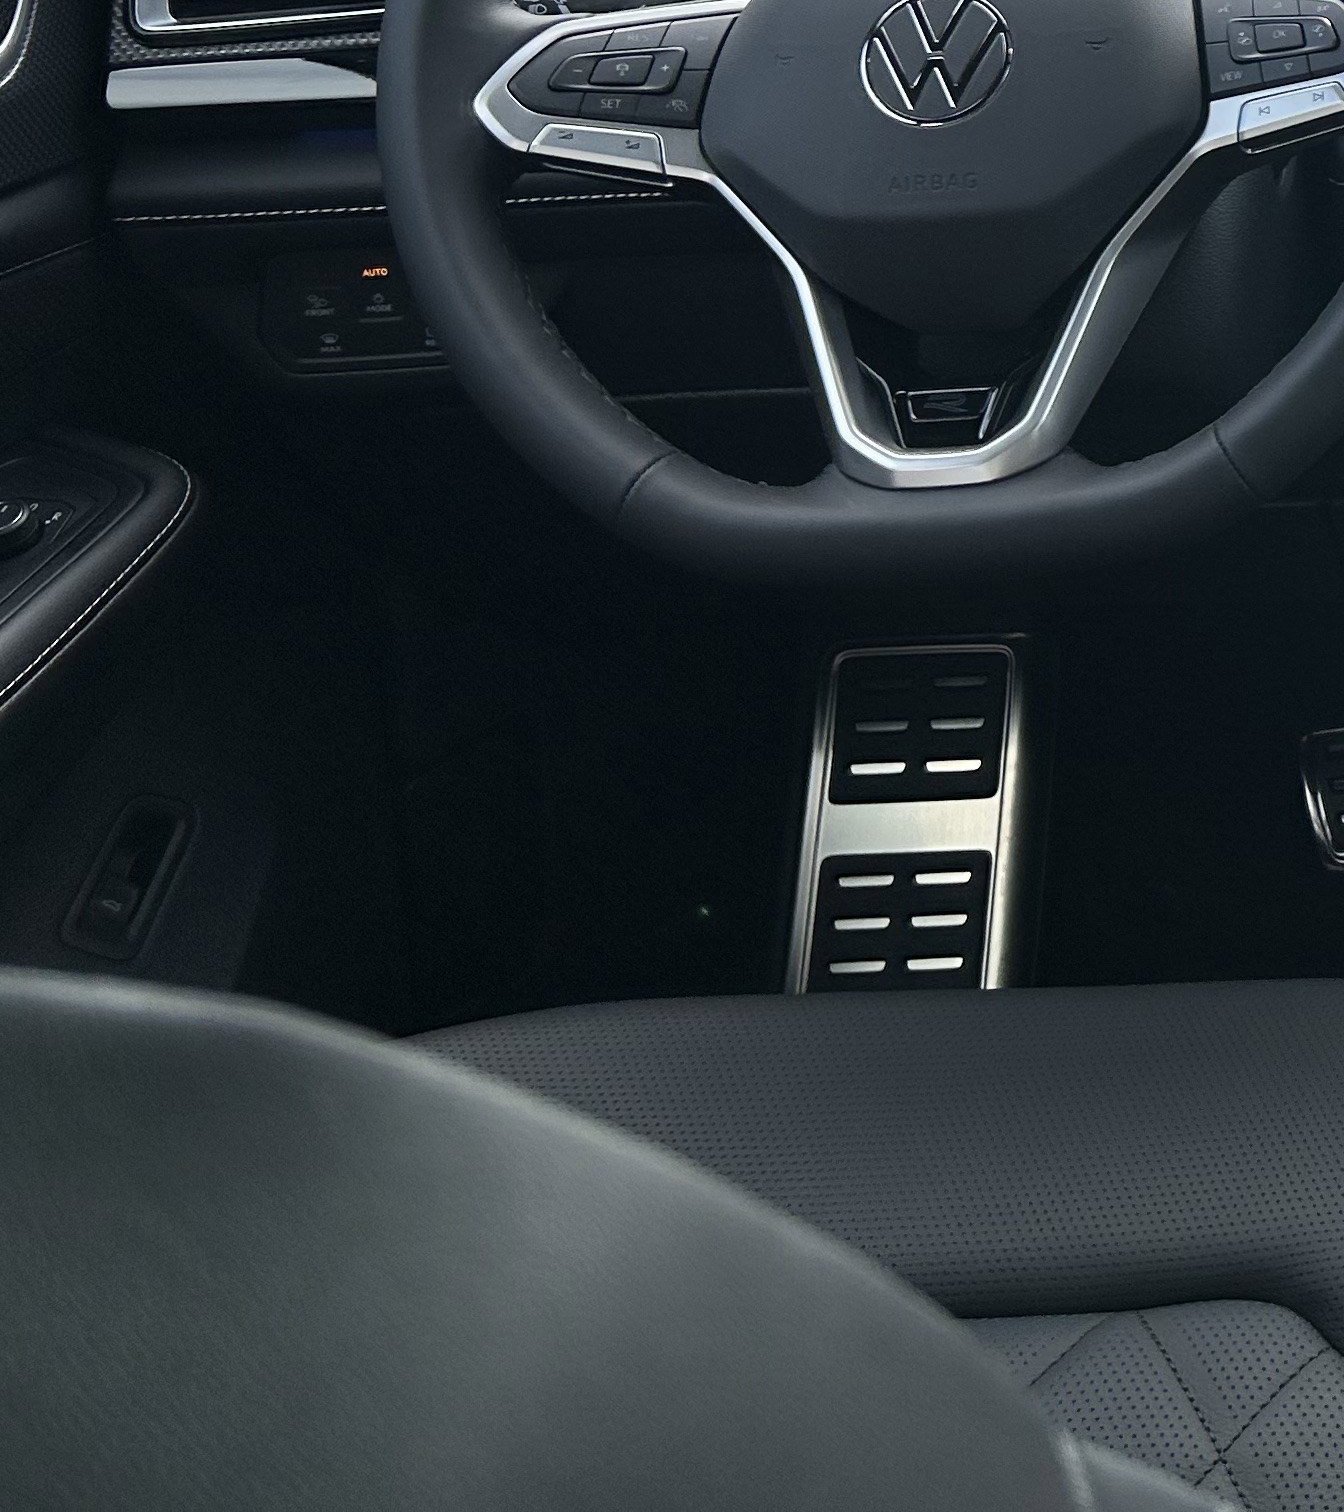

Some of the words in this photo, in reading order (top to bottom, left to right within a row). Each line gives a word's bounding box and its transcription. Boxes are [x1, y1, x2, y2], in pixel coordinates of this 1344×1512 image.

[1220, 70, 1244, 82] VIEW
[600, 98, 622, 109] SET
[362, 267, 389, 278] AUTO
